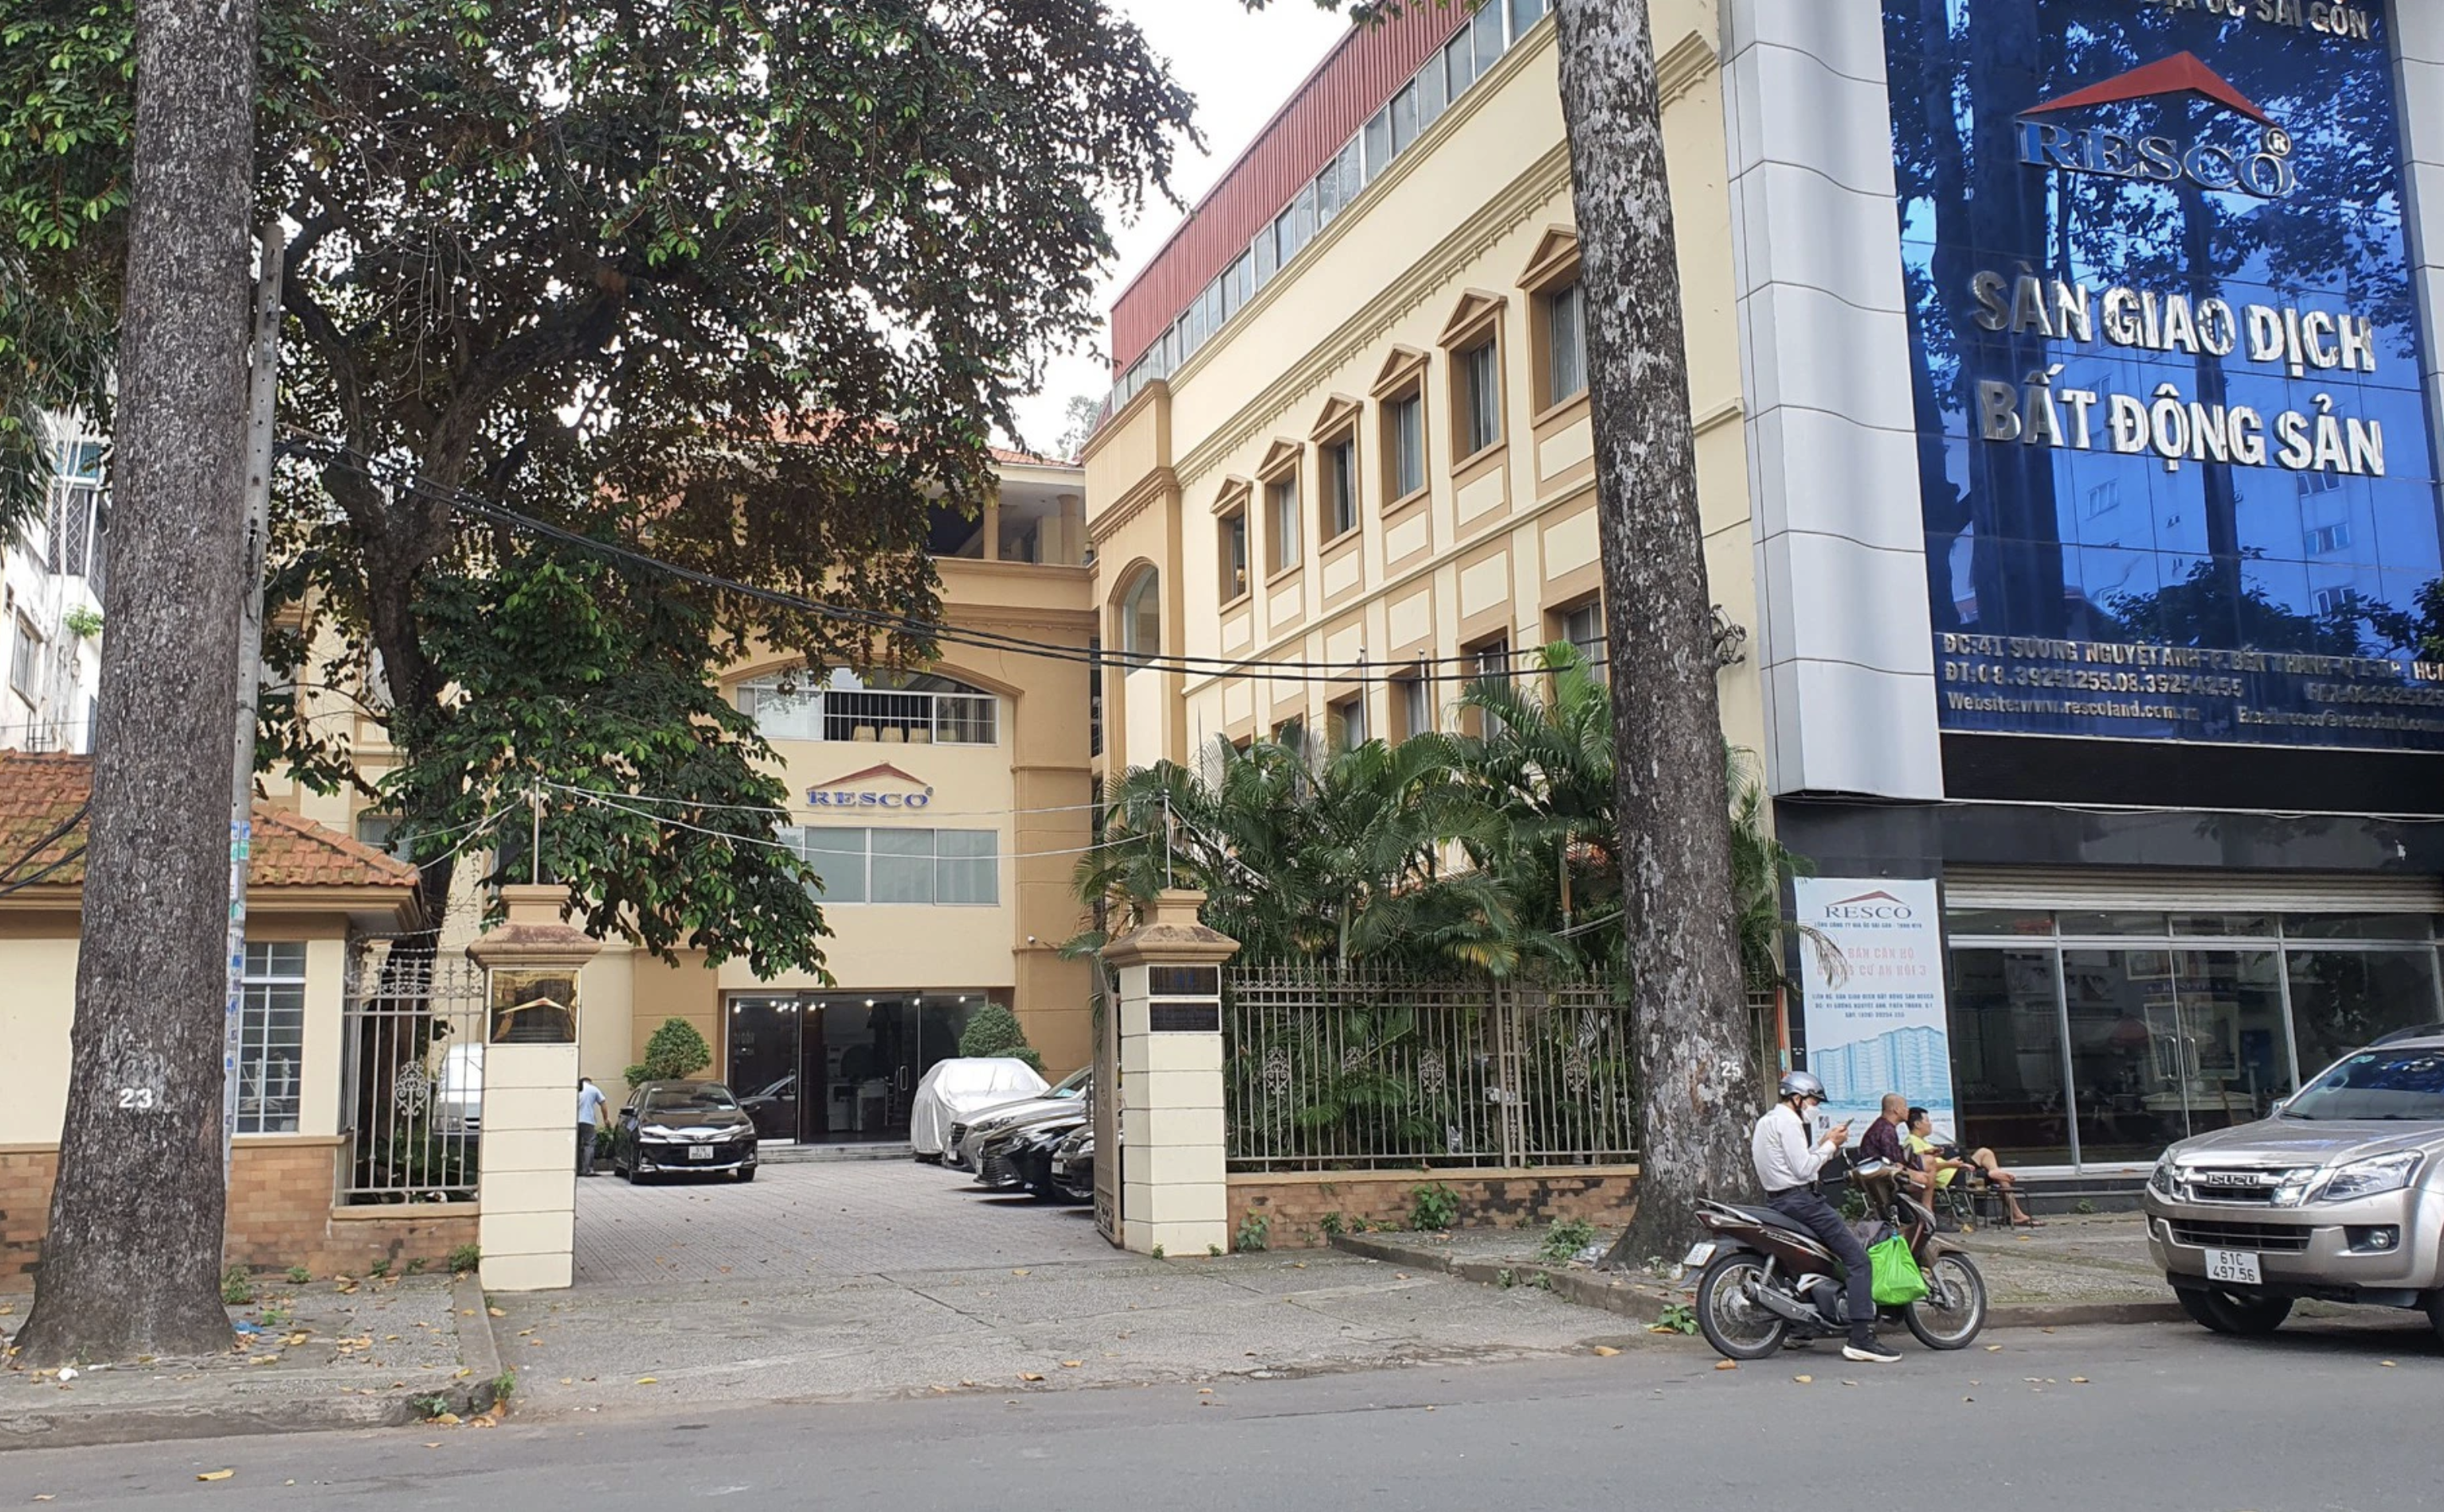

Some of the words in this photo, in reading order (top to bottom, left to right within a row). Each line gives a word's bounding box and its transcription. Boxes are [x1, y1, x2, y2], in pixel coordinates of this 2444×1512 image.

[1968, 260, 2090, 343] SÀN
[2101, 286, 2235, 356] GIAO
[2242, 304, 2377, 378] DỊCH
[1978, 362, 2096, 450] BẤT
[2108, 382, 2267, 472] ĐỘNG
[2273, 393, 2385, 476] SẢN
[2085, 640, 2158, 671] NGUYỆT
[1823, 905, 1912, 919] RESCO
[1721, 1061, 1741, 1076] 25
[119, 1088, 152, 1108] 23
[2209, 1174, 2259, 1185] ISUZU
[2220, 1252, 2244, 1266] 61C
[2213, 1266, 2255, 1282] 497.56
